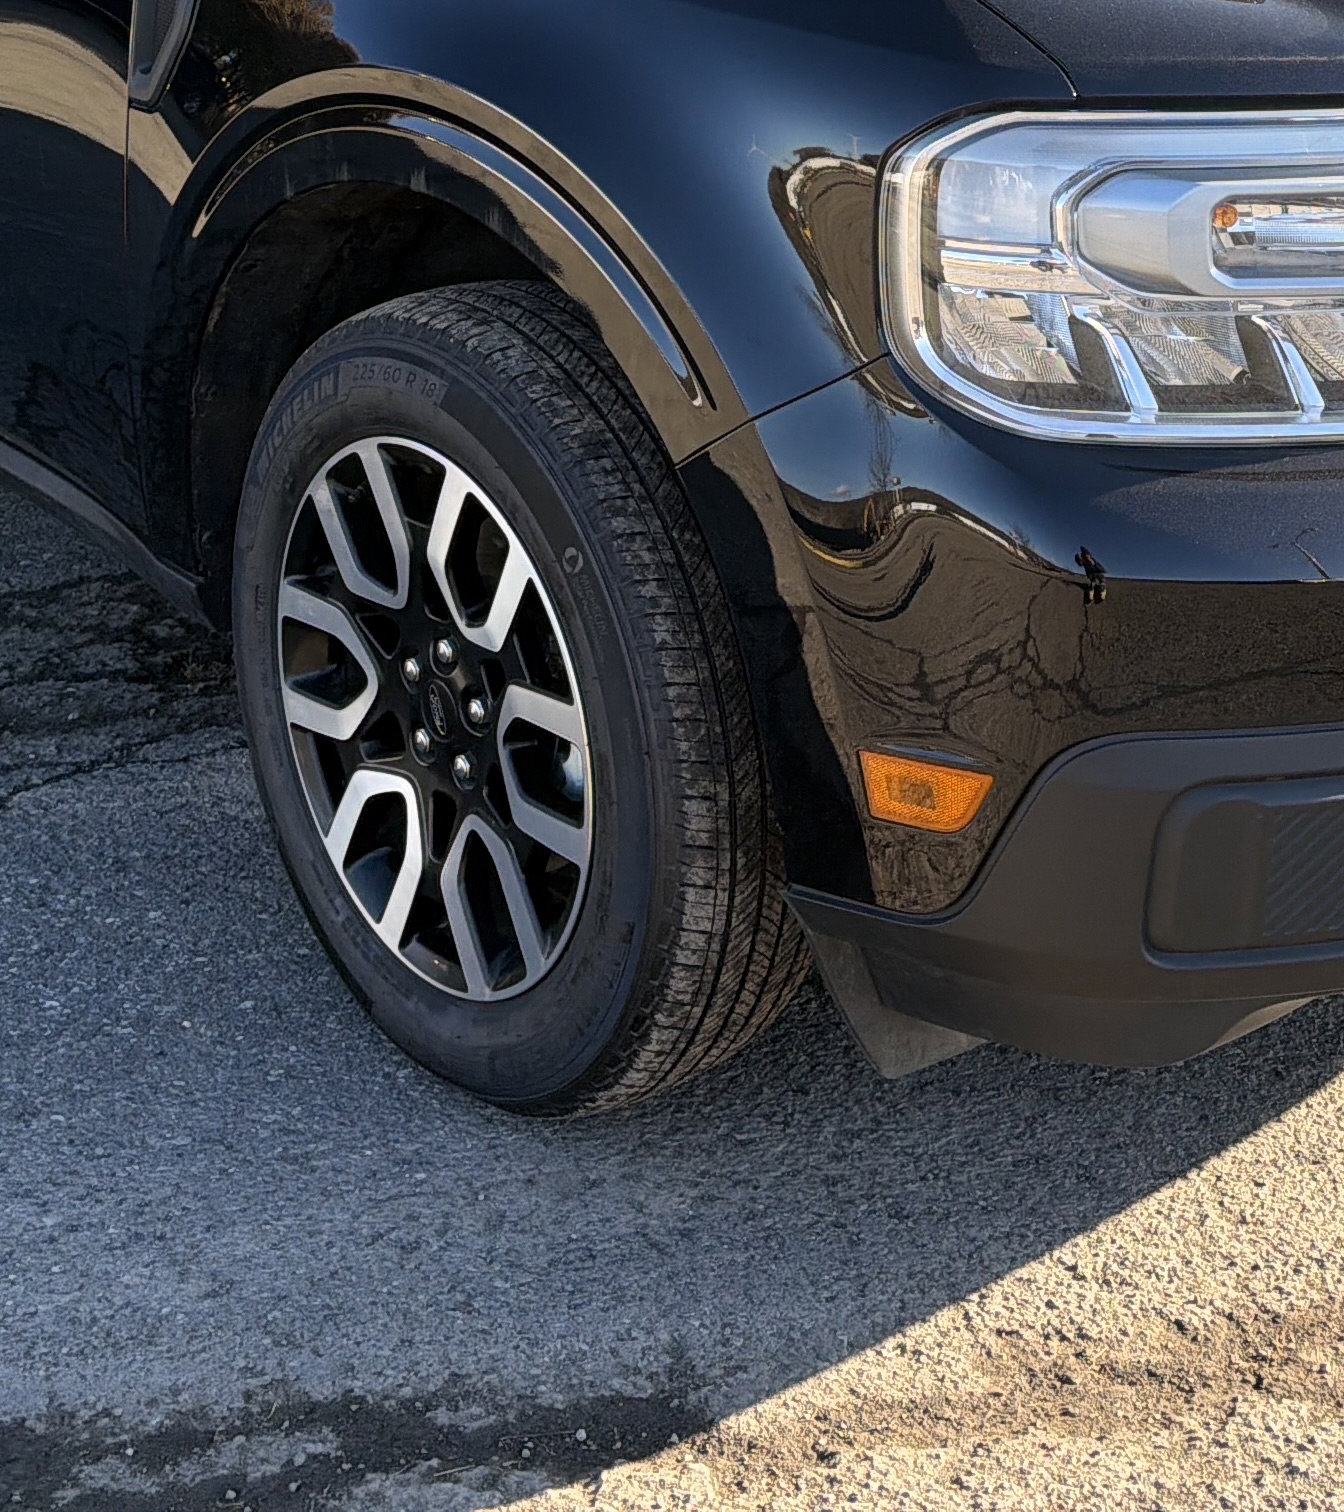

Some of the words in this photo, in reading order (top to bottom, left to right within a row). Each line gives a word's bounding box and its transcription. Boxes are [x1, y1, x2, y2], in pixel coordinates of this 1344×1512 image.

[352, 363, 402, 384] 225/60
[405, 370, 417, 388] R
[421, 378, 437, 398] 18
